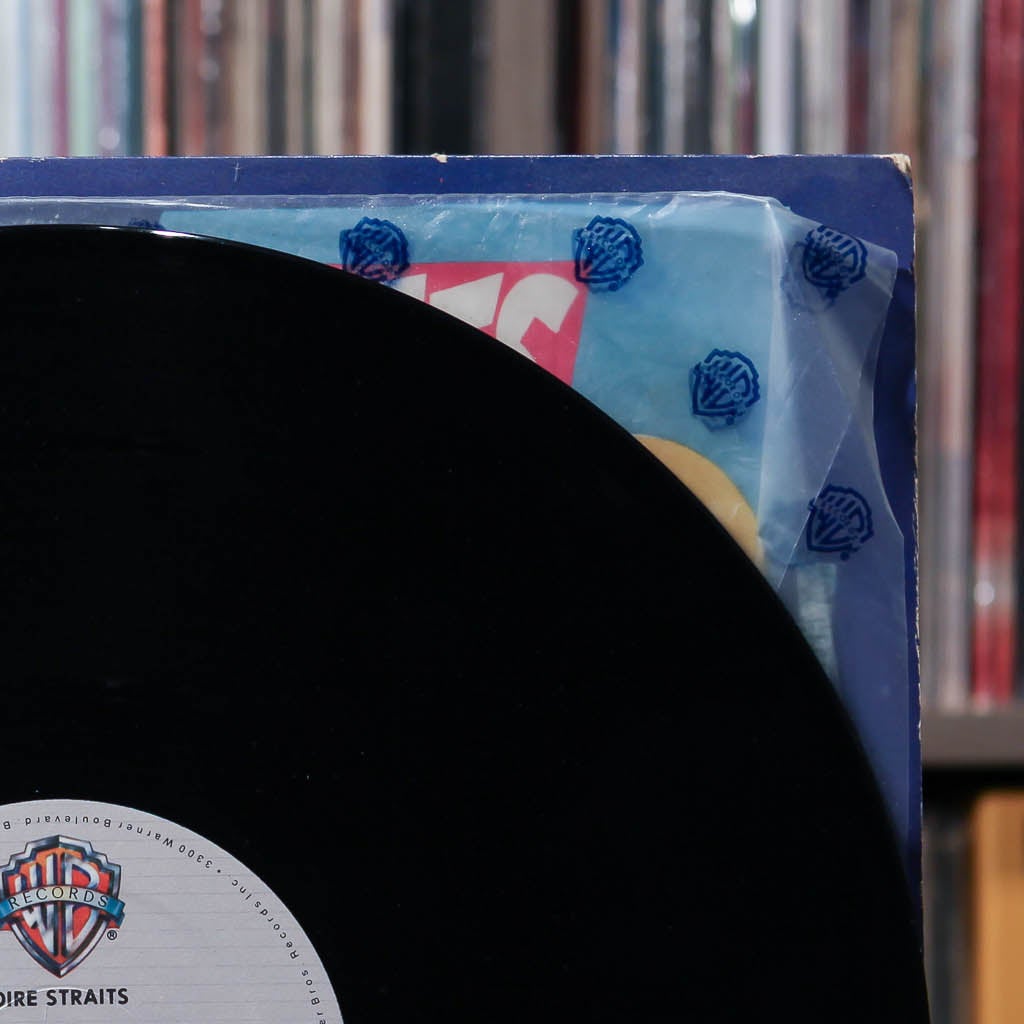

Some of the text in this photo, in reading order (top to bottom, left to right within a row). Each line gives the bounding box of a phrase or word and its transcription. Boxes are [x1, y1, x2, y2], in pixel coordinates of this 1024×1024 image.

[118, 821, 174, 848] Warner
[178, 844, 213, 869] 3300
[7, 884, 110, 912] RECORDS
[254, 900, 300, 960] Records
[45, 987, 129, 1007] STRAITS
